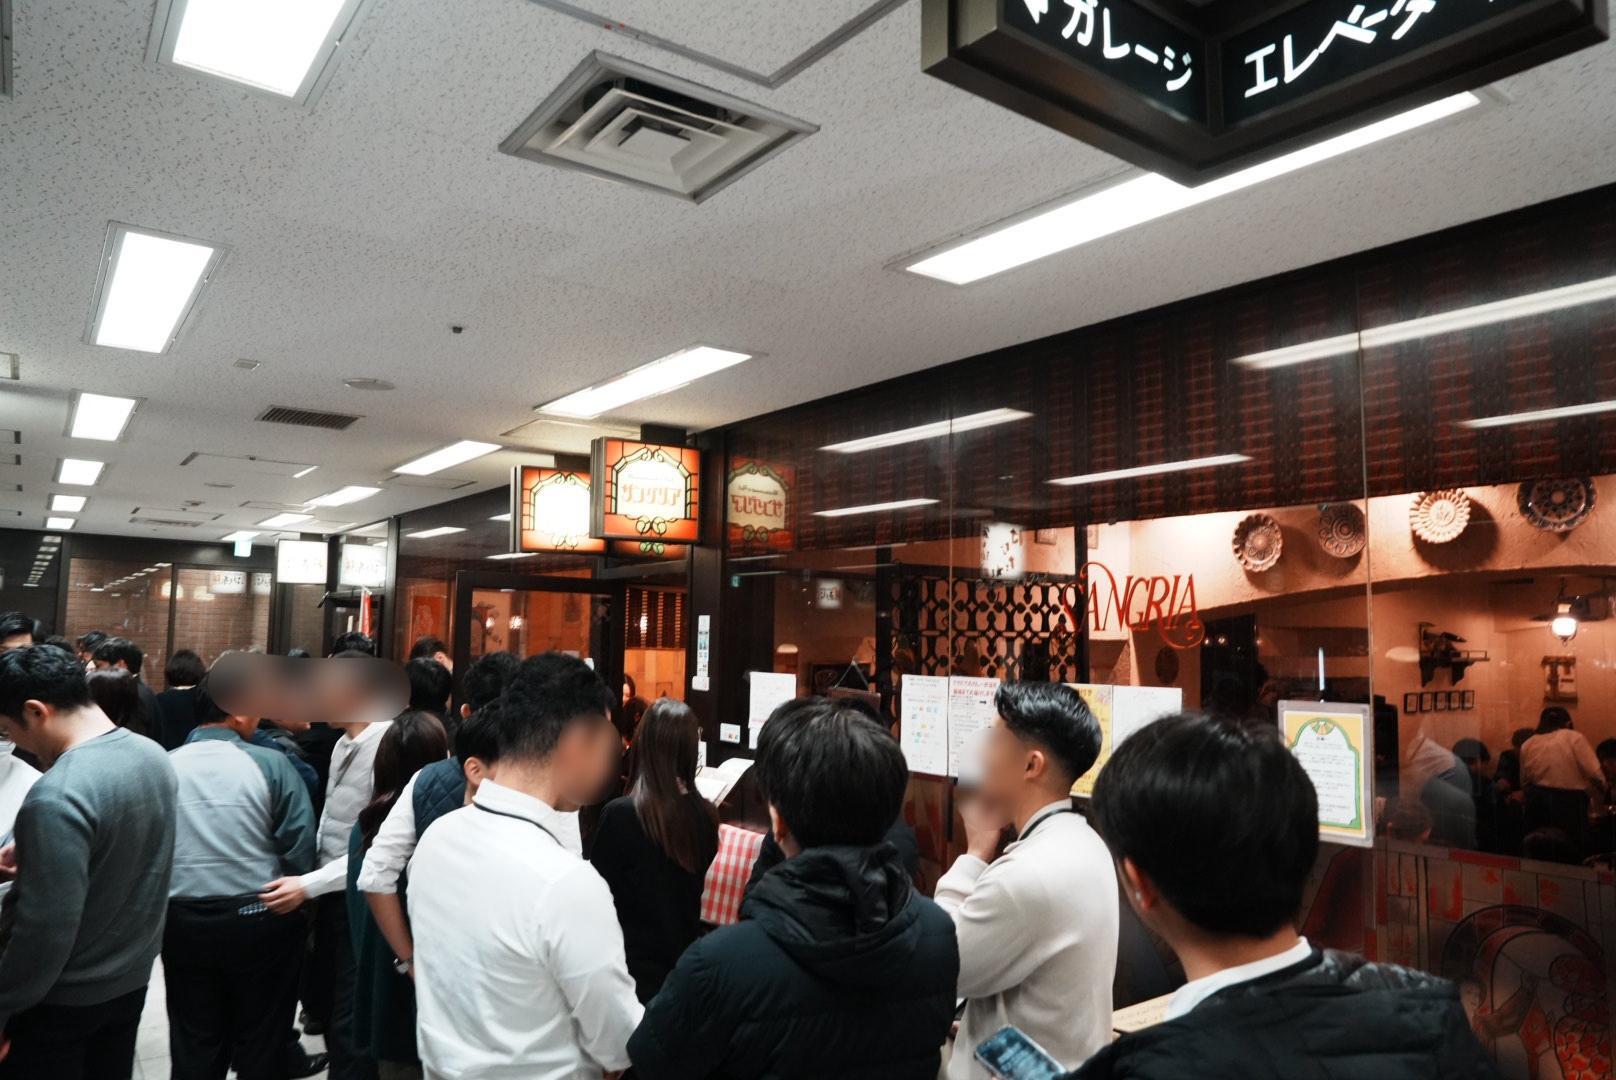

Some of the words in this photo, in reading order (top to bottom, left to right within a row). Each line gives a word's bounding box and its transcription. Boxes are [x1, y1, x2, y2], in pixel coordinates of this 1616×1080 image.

[1061, 0, 1192, 91] ガレージ
[1058, 562, 1205, 649] SANGRIA
